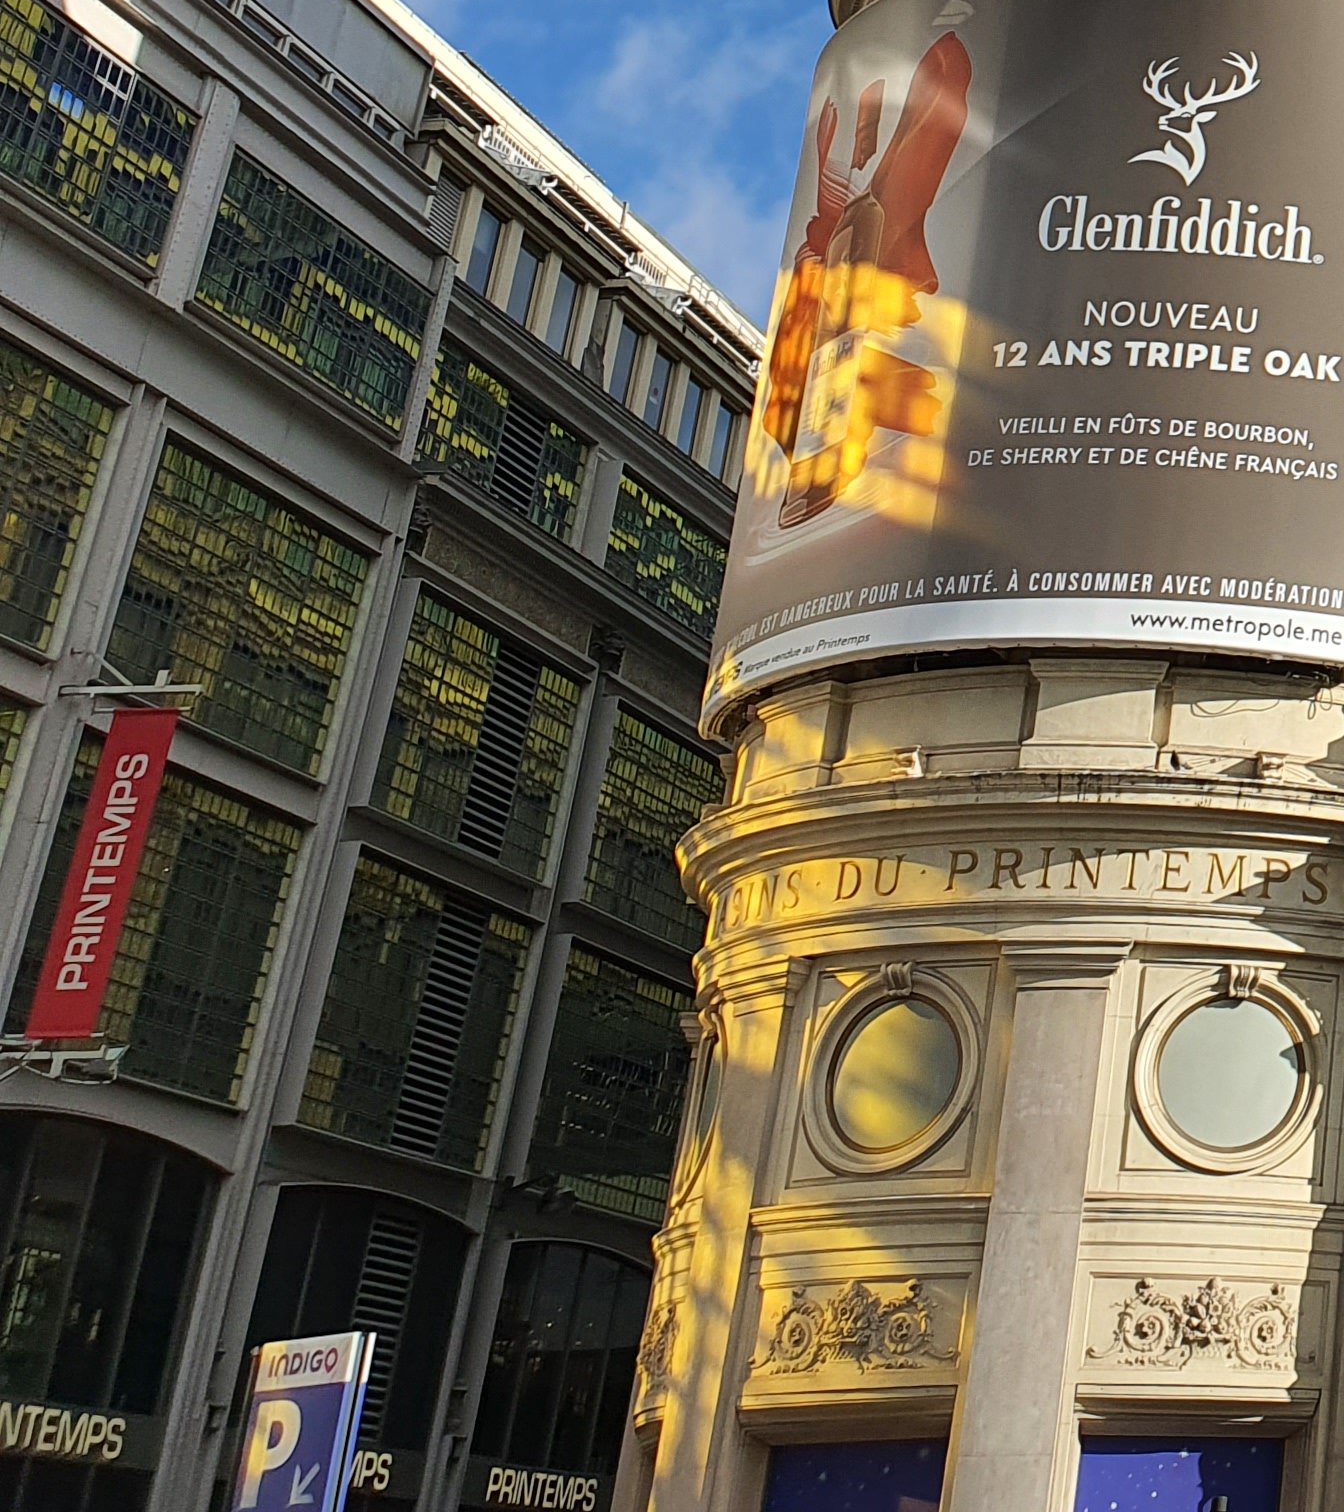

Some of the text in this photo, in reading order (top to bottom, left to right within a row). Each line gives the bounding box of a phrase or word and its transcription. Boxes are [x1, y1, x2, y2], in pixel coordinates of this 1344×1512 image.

[1084, 301, 1259, 333] NOUVEAU
[993, 340, 1342, 382] 12 ANS TRIPLE OAK
[999, 413, 1314, 450] VIEILLI EN FÛTS DE BOURBON,
[967, 445, 1338, 480] DE SHERRY ET DE CHÊNE FRANÇAIS
[759, 613, 780, 636] EST
[780, 590, 854, 627] DANGEREUX
[859, 582, 899, 606] POUR
[905, 578, 925, 599] LA
[933, 569, 999, 596] SANTÉ.
[1006, 568, 1019, 592] À
[1028, 571, 1154, 593] CONSOMMER
[1161, 574, 1212, 596] AVEC
[816, 633, 870, 654] Printemps
[1130, 613, 1343, 645] www.metropole.me
[55, 753, 149, 991] PRINTEMPS
[833, 853, 907, 904] DU
[944, 845, 1330, 905] PRINTEMPS
[267, 1347, 339, 1378] INDIGO
[239, 1399, 302, 1509] P
[486, 1466, 598, 1512] PRINTEMPS
